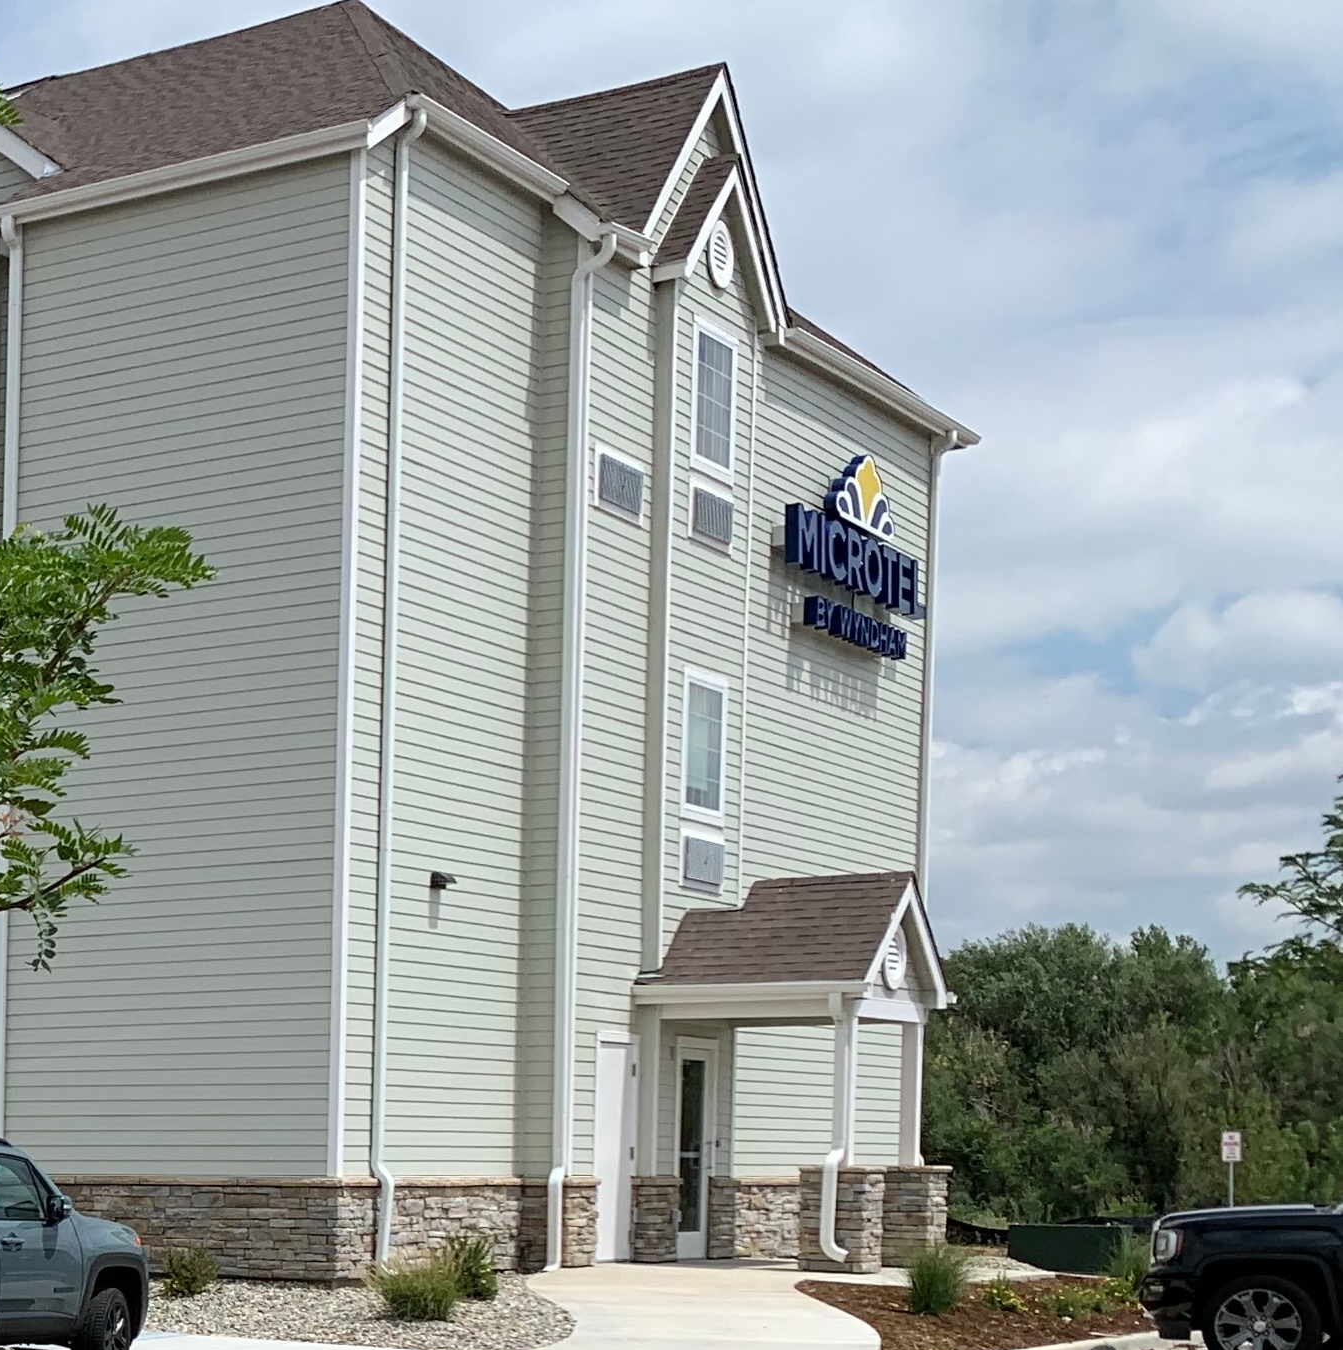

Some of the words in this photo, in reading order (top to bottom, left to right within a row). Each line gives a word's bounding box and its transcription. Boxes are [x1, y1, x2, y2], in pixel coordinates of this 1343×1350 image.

[795, 505, 927, 620] MICROTEL
[814, 596, 835, 629] BY
[837, 605, 908, 660] WYNDHAM
